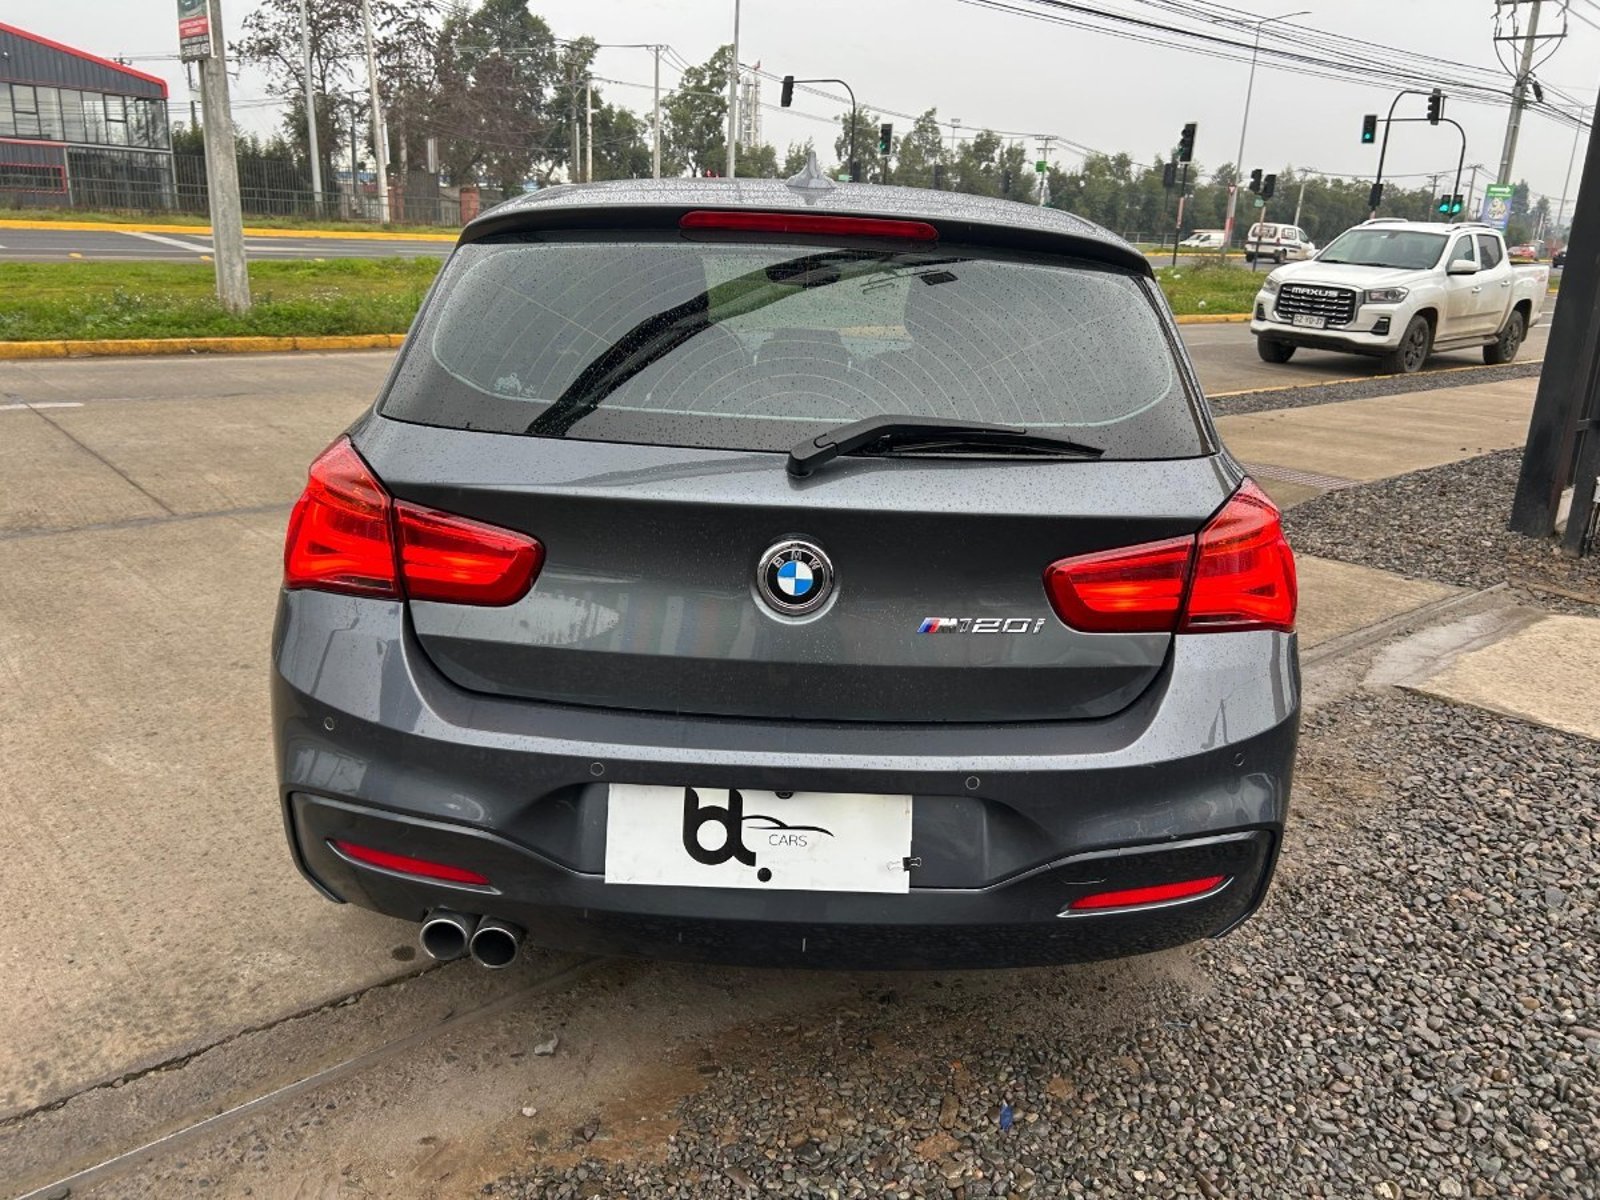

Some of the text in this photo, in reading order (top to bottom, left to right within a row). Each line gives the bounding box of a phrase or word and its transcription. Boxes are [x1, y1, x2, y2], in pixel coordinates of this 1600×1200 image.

[1292, 287, 1338, 297] MAXUS
[772, 550, 821, 570] BMW
[768, 833, 808, 848] CARS
